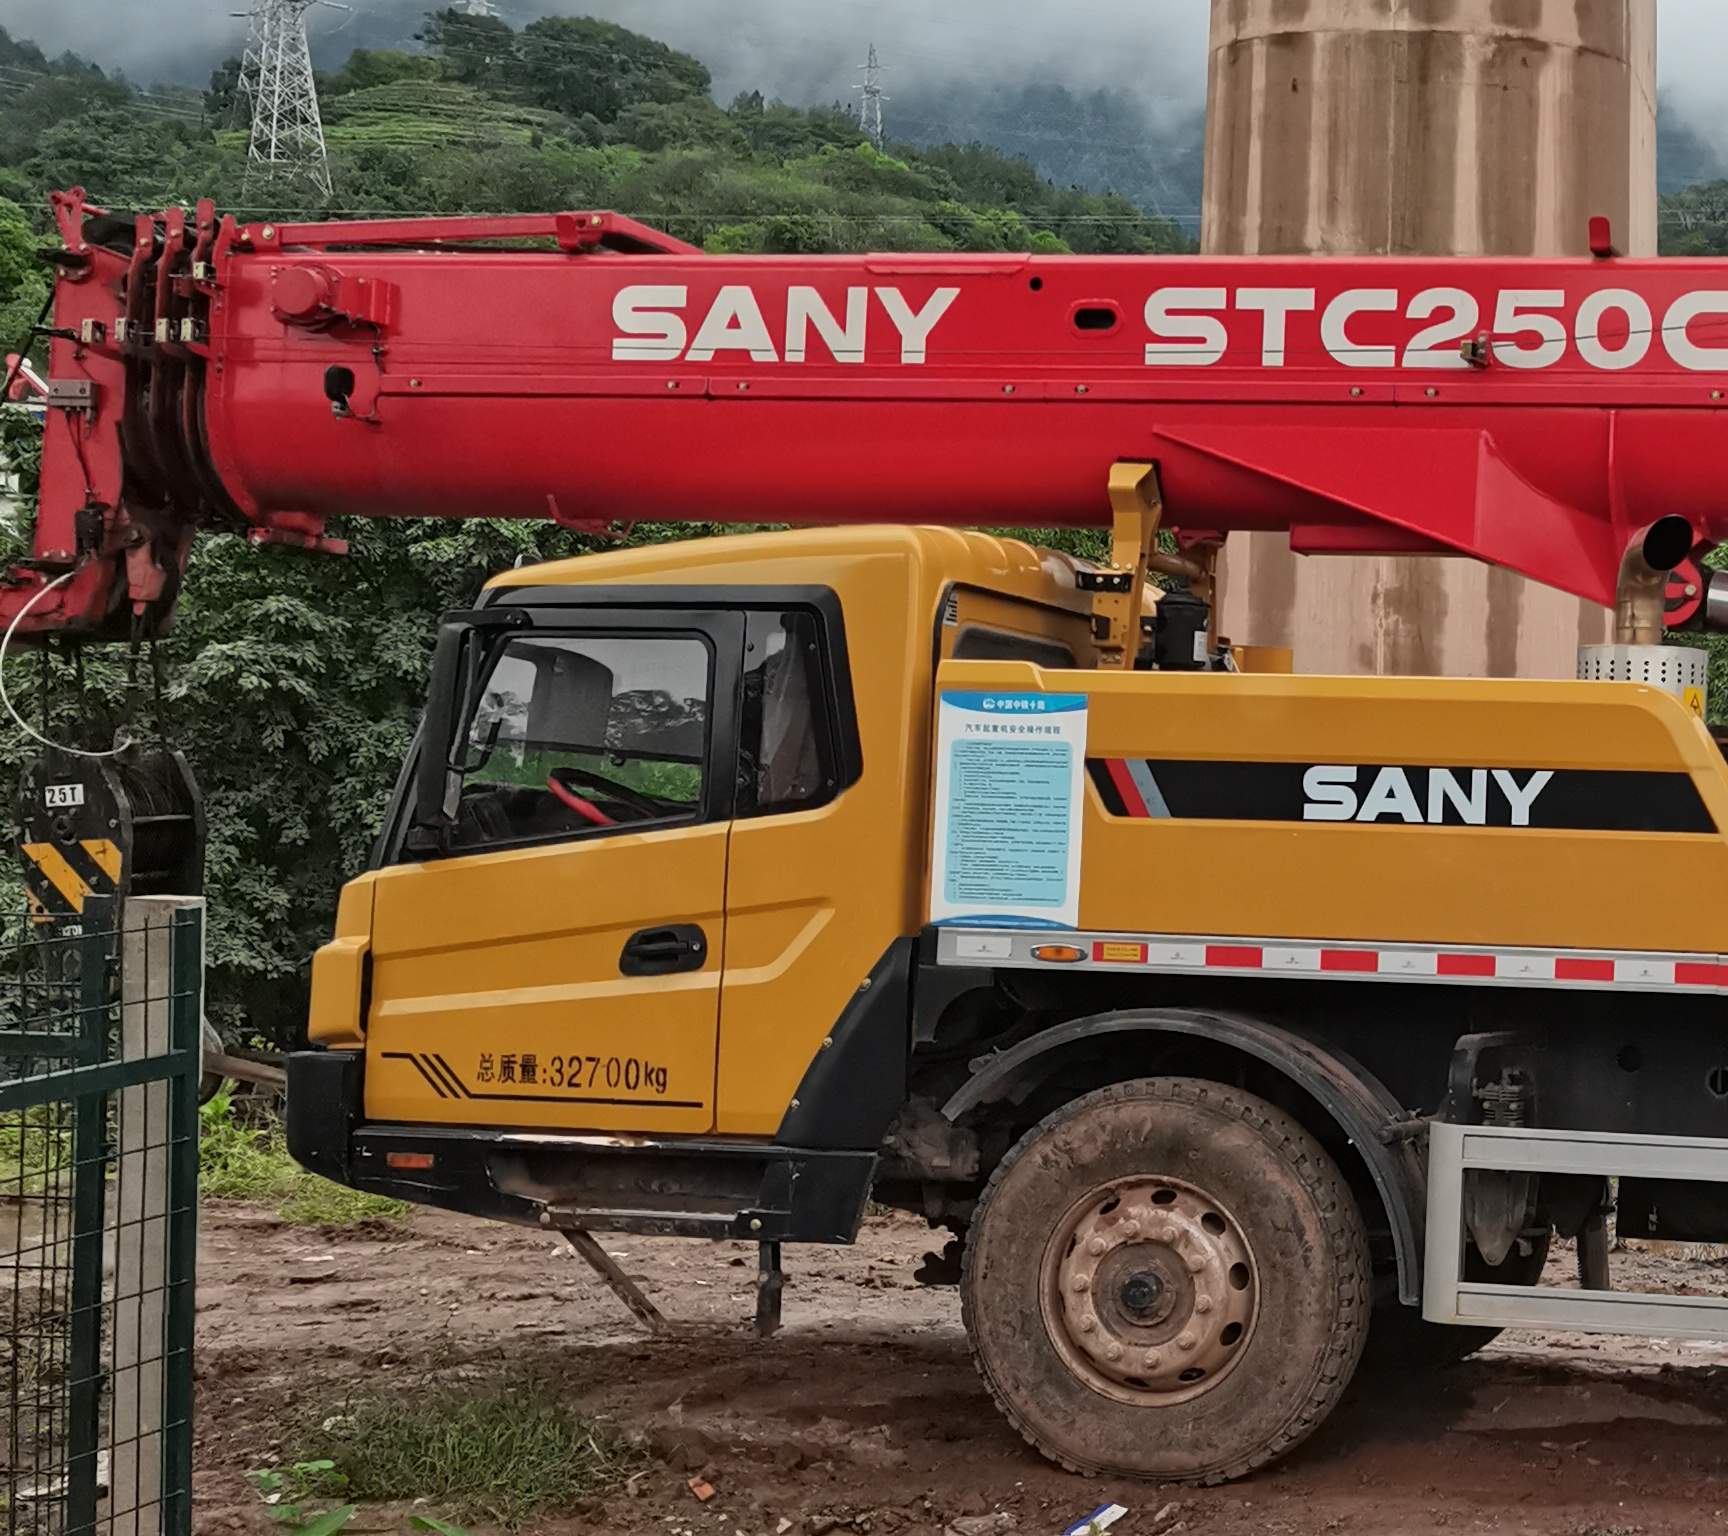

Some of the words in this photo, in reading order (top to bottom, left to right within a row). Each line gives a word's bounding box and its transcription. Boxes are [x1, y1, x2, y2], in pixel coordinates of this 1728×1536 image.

[612, 285, 961, 364] SANY
[46, 786, 78, 804] 25T
[1302, 765, 1555, 826] SANY
